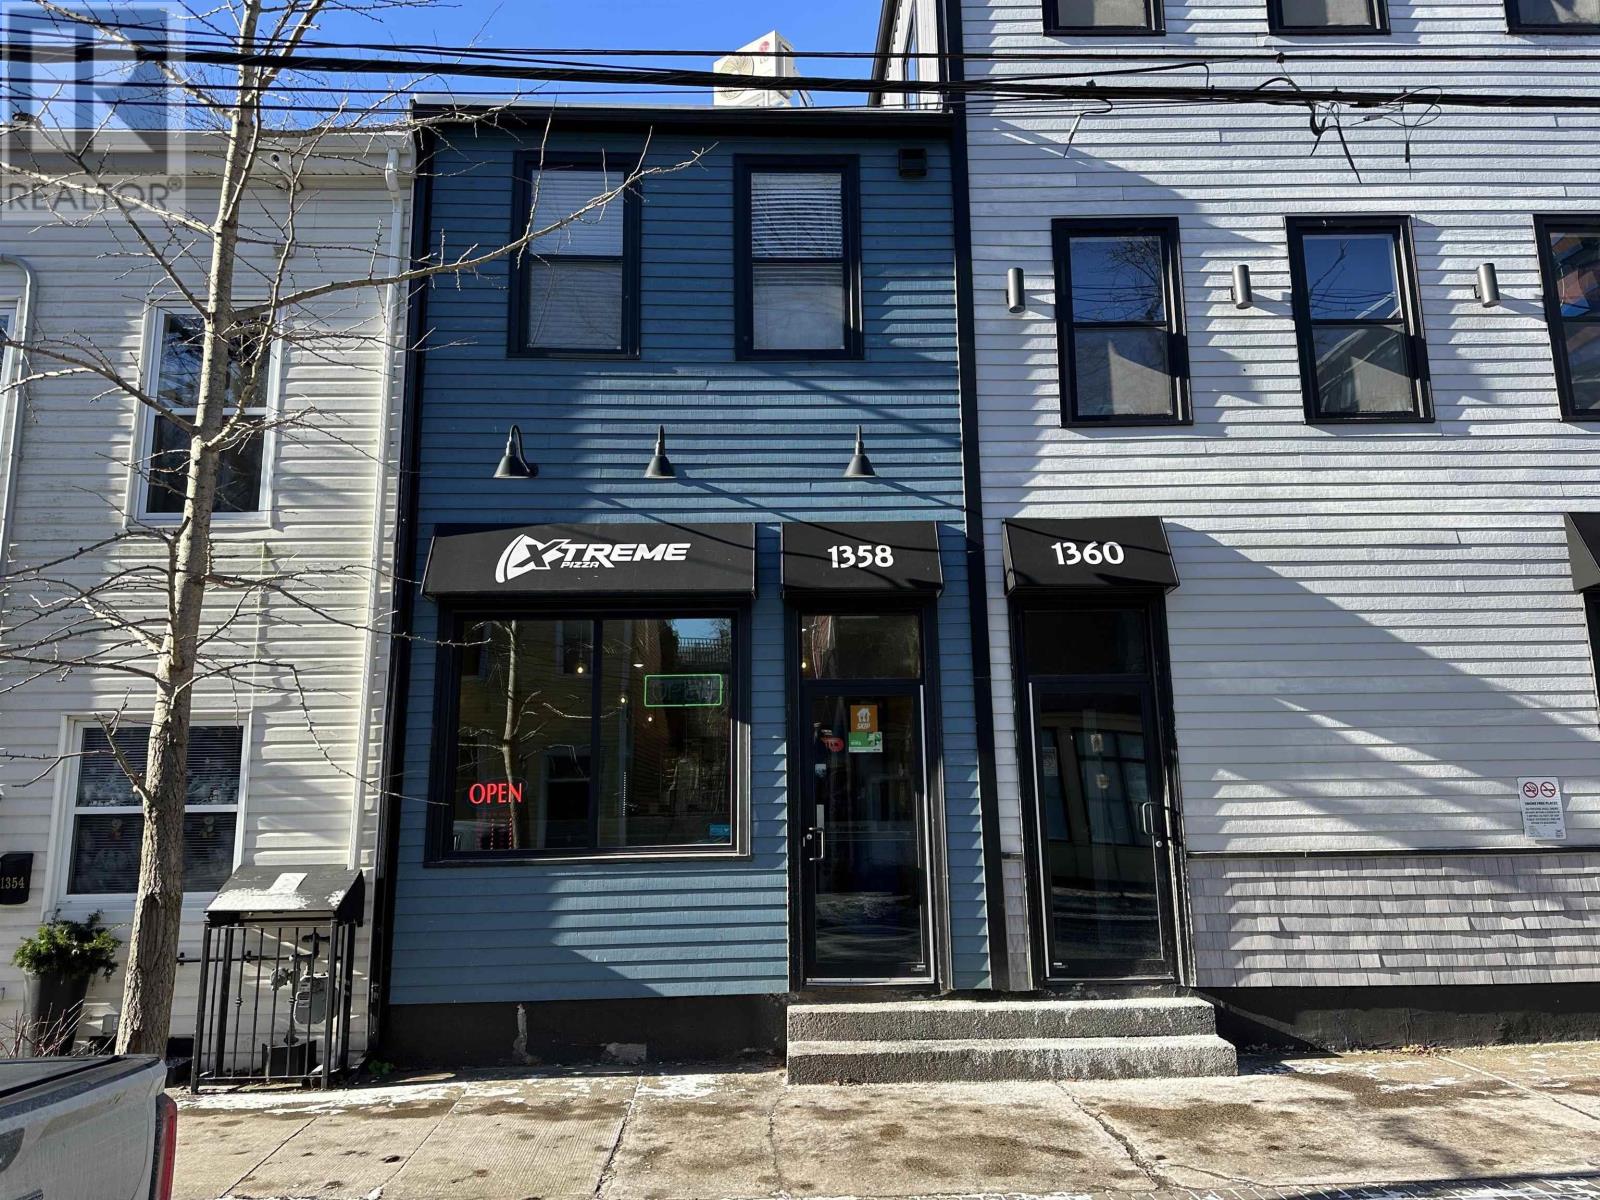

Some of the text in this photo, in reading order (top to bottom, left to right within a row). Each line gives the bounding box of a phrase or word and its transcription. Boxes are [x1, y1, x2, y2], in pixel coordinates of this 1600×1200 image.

[827, 545, 894, 568] 1358
[1051, 541, 1124, 565] 1360
[560, 561, 599, 569] PIZZA
[469, 782, 522, 804] OPEN
[1, 876, 25, 889] 1354
